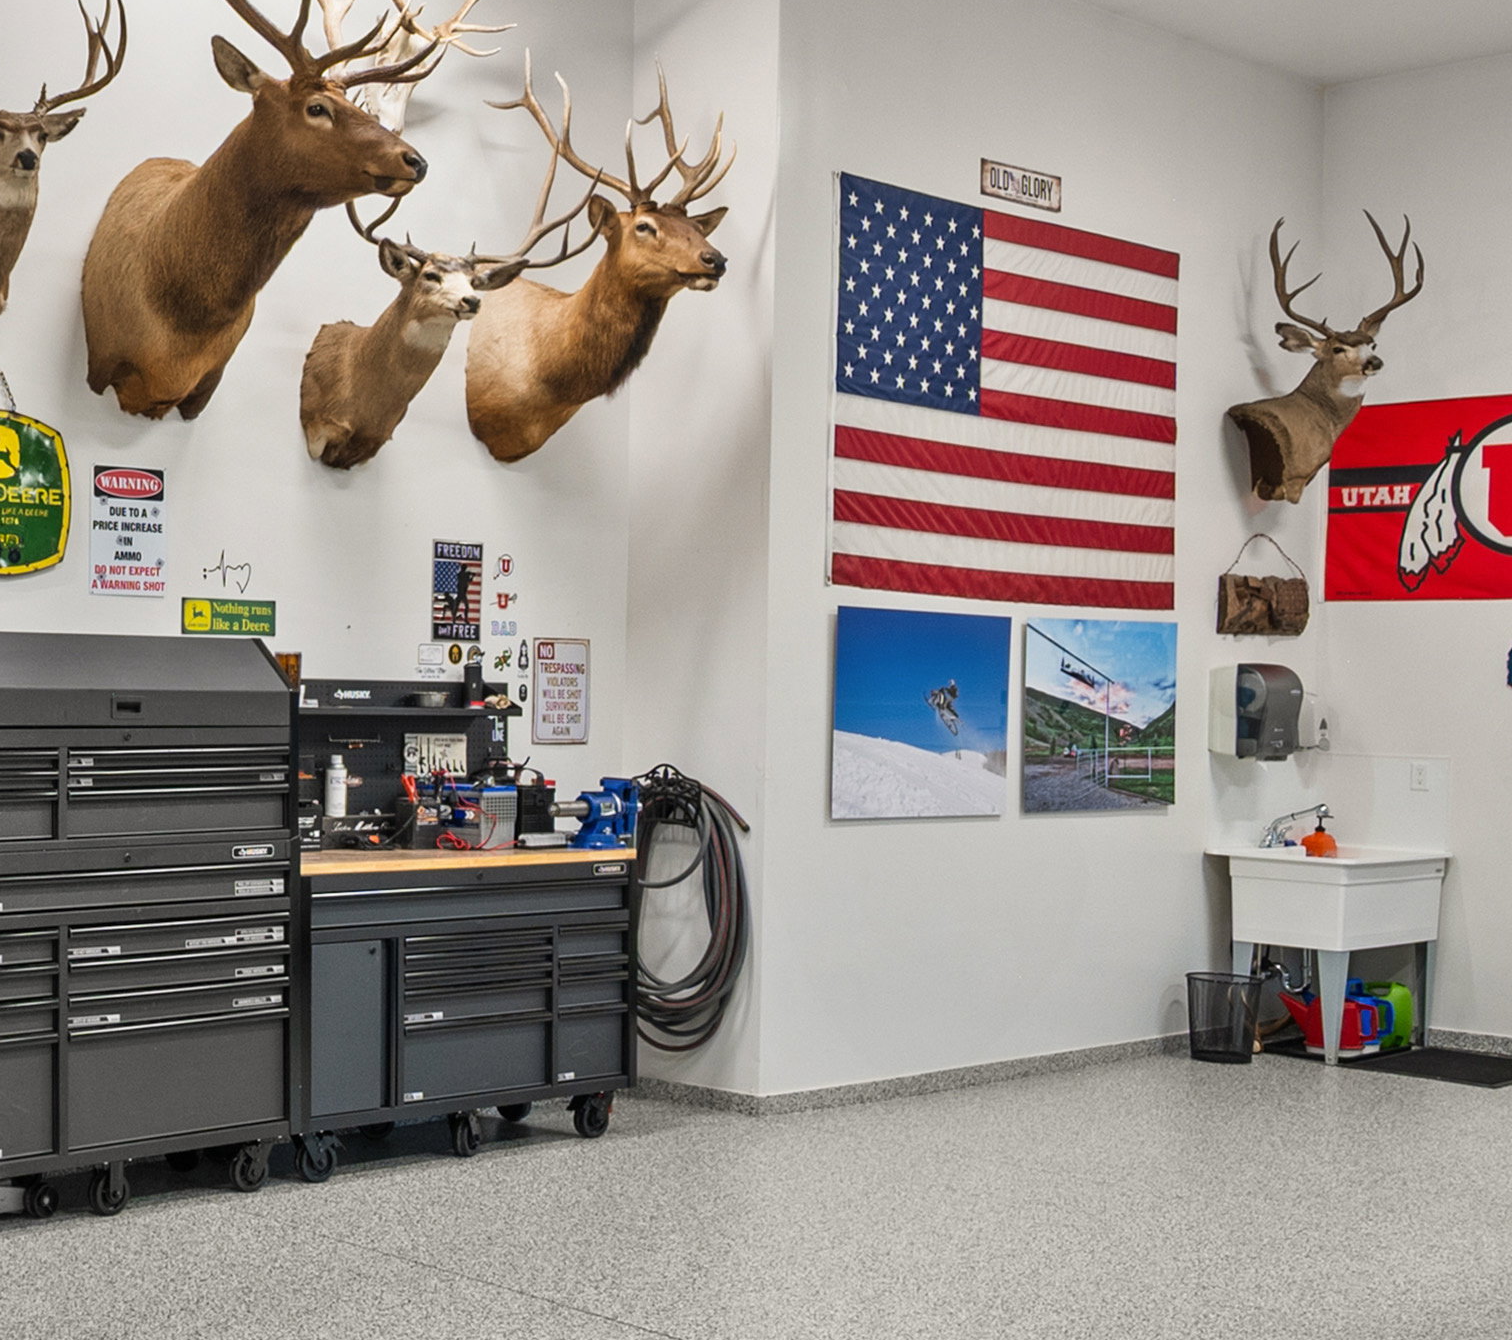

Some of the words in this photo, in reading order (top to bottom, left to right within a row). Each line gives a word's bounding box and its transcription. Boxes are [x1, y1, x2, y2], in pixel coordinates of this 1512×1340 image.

[990, 167, 1009, 191] OLD
[1022, 174, 1053, 201] GLORY
[99, 475, 158, 491] WARNING
[1341, 485, 1411, 506] UTAH
[109, 506, 126, 516] DUE
[129, 507, 139, 517] TO
[141, 508, 147, 518] A
[93, 520, 118, 531] PRICE
[121, 522, 163, 533] INCREASE
[123, 537, 133, 546] IN
[114, 551, 142, 562] AMMO
[437, 543, 480, 558] FREEDOM
[94, 564, 107, 575] DO
[109, 565, 126, 576] NOT
[129, 566, 161, 577] EXPECT
[91, 579, 98, 589] A
[100, 579, 141, 590] WARNING
[143, 581, 165, 591] SHOT
[212, 602, 250, 617] Nothing
[251, 606, 272, 616] runs
[212, 618, 230, 631] like
[232, 622, 239, 631] a
[242, 619, 270, 632] Deere
[453, 624, 476, 638] FREE
[491, 621, 517, 636] DAD
[540, 644, 553, 658] NO
[540, 662, 585, 675] TRESPASSING
[546, 677, 578, 687] VIOLATORS
[344, 690, 371, 699] HUSKY
[557, 690, 565, 699] BE
[566, 690, 582, 699] SHOT
[552, 726, 570, 736] AGAIN
